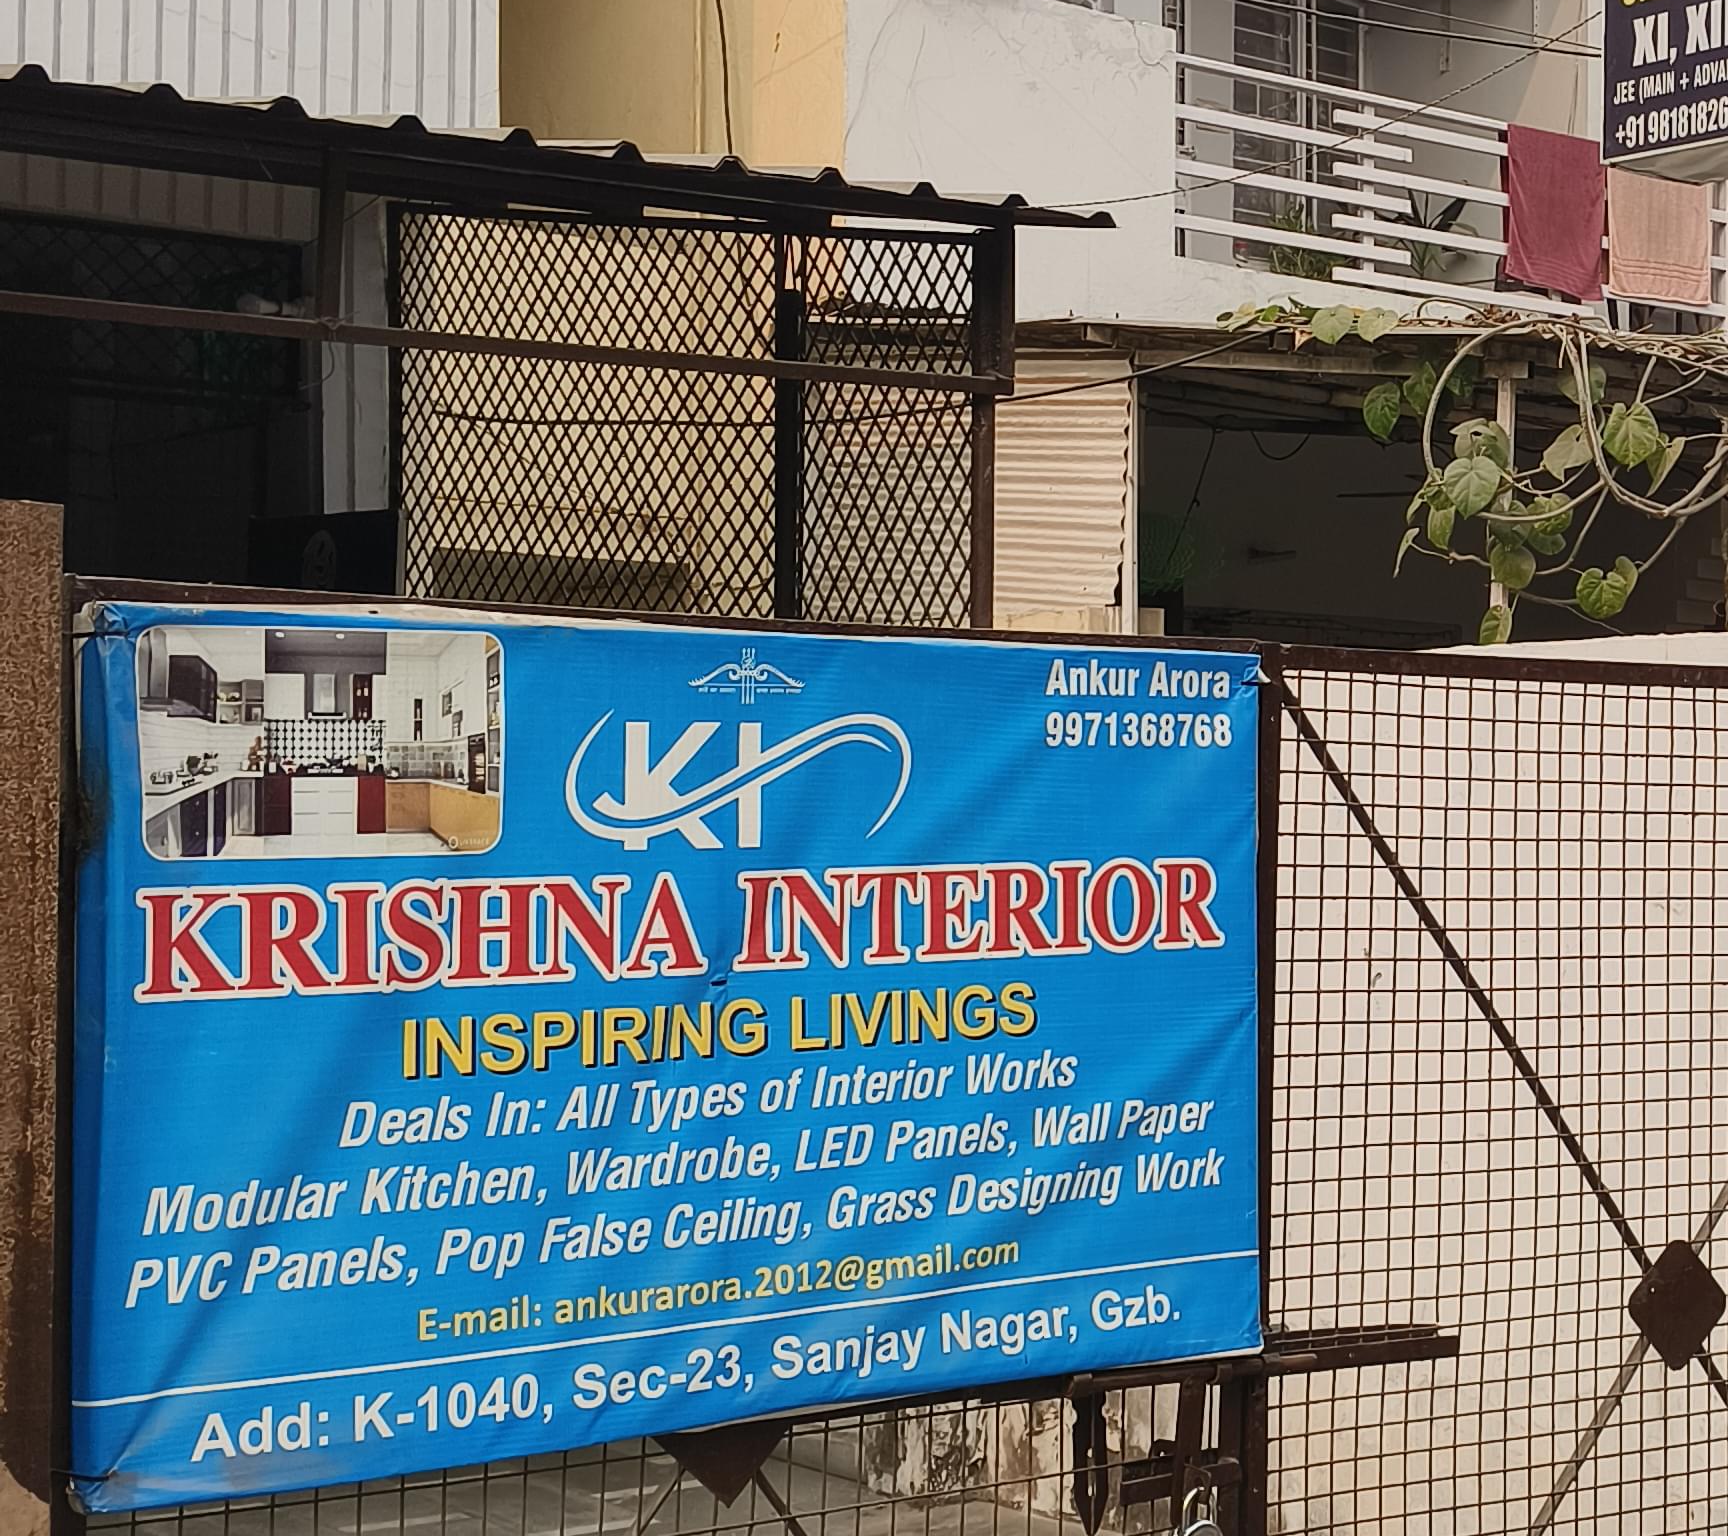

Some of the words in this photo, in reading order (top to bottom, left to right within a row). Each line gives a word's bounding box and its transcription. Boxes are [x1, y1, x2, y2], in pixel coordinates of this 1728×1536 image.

[1614, 79, 1635, 105] JEE
[1639, 70, 1674, 104] (MAIN
[1680, 72, 1689, 91] +
[1633, 12, 1678, 67] XI,
[1045, 658, 1140, 697] Ankur
[1149, 661, 1230, 699] Arora
[1046, 711, 1232, 747] 9971368768
[134, 872, 708, 1004] KRISHNA
[733, 857, 1224, 971] INTERIOR
[403, 997, 767, 1079] INSPIRING
[790, 982, 1037, 1052] LIVINGS
[339, 1095, 472, 1148] Deals
[485, 1091, 547, 1137] In:
[556, 1083, 619, 1131] All
[631, 1078, 745, 1133] Types
[760, 1069, 802, 1113] of
[811, 1059, 954, 1110] Interior
[966, 1050, 1077, 1094] Works
[141, 1174, 348, 1236] Modular
[360, 1161, 547, 1214] Kitchen,
[567, 1136, 780, 1195] Wardrobe,
[794, 1124, 874, 1172] LED
[886, 1113, 1017, 1162] Panels,
[1032, 1102, 1112, 1147] Wall
[1117, 1099, 1215, 1142] Paper
[125, 1251, 231, 1309] PVC
[242, 1236, 419, 1295] Panels,
[435, 1228, 524, 1279] Pop
[539, 1212, 652, 1263] False
[663, 1197, 811, 1248] Ceiling,
[827, 1185, 936, 1230] Grass
[947, 1162, 1122, 1216] Designing
[1136, 1148, 1225, 1193] Work
[417, 1295, 542, 1341] E-mail:
[553, 1238, 1020, 1325] ankurarora.2012@gmail.com
[190, 1401, 330, 1462] Add:
[353, 1372, 553, 1443] K-1040,
[572, 1345, 754, 1410] Sec-23,
[771, 1323, 926, 1380] Sanjay
[940, 1305, 1079, 1356] Nagar,
[1091, 1284, 1181, 1332] Gzb.
